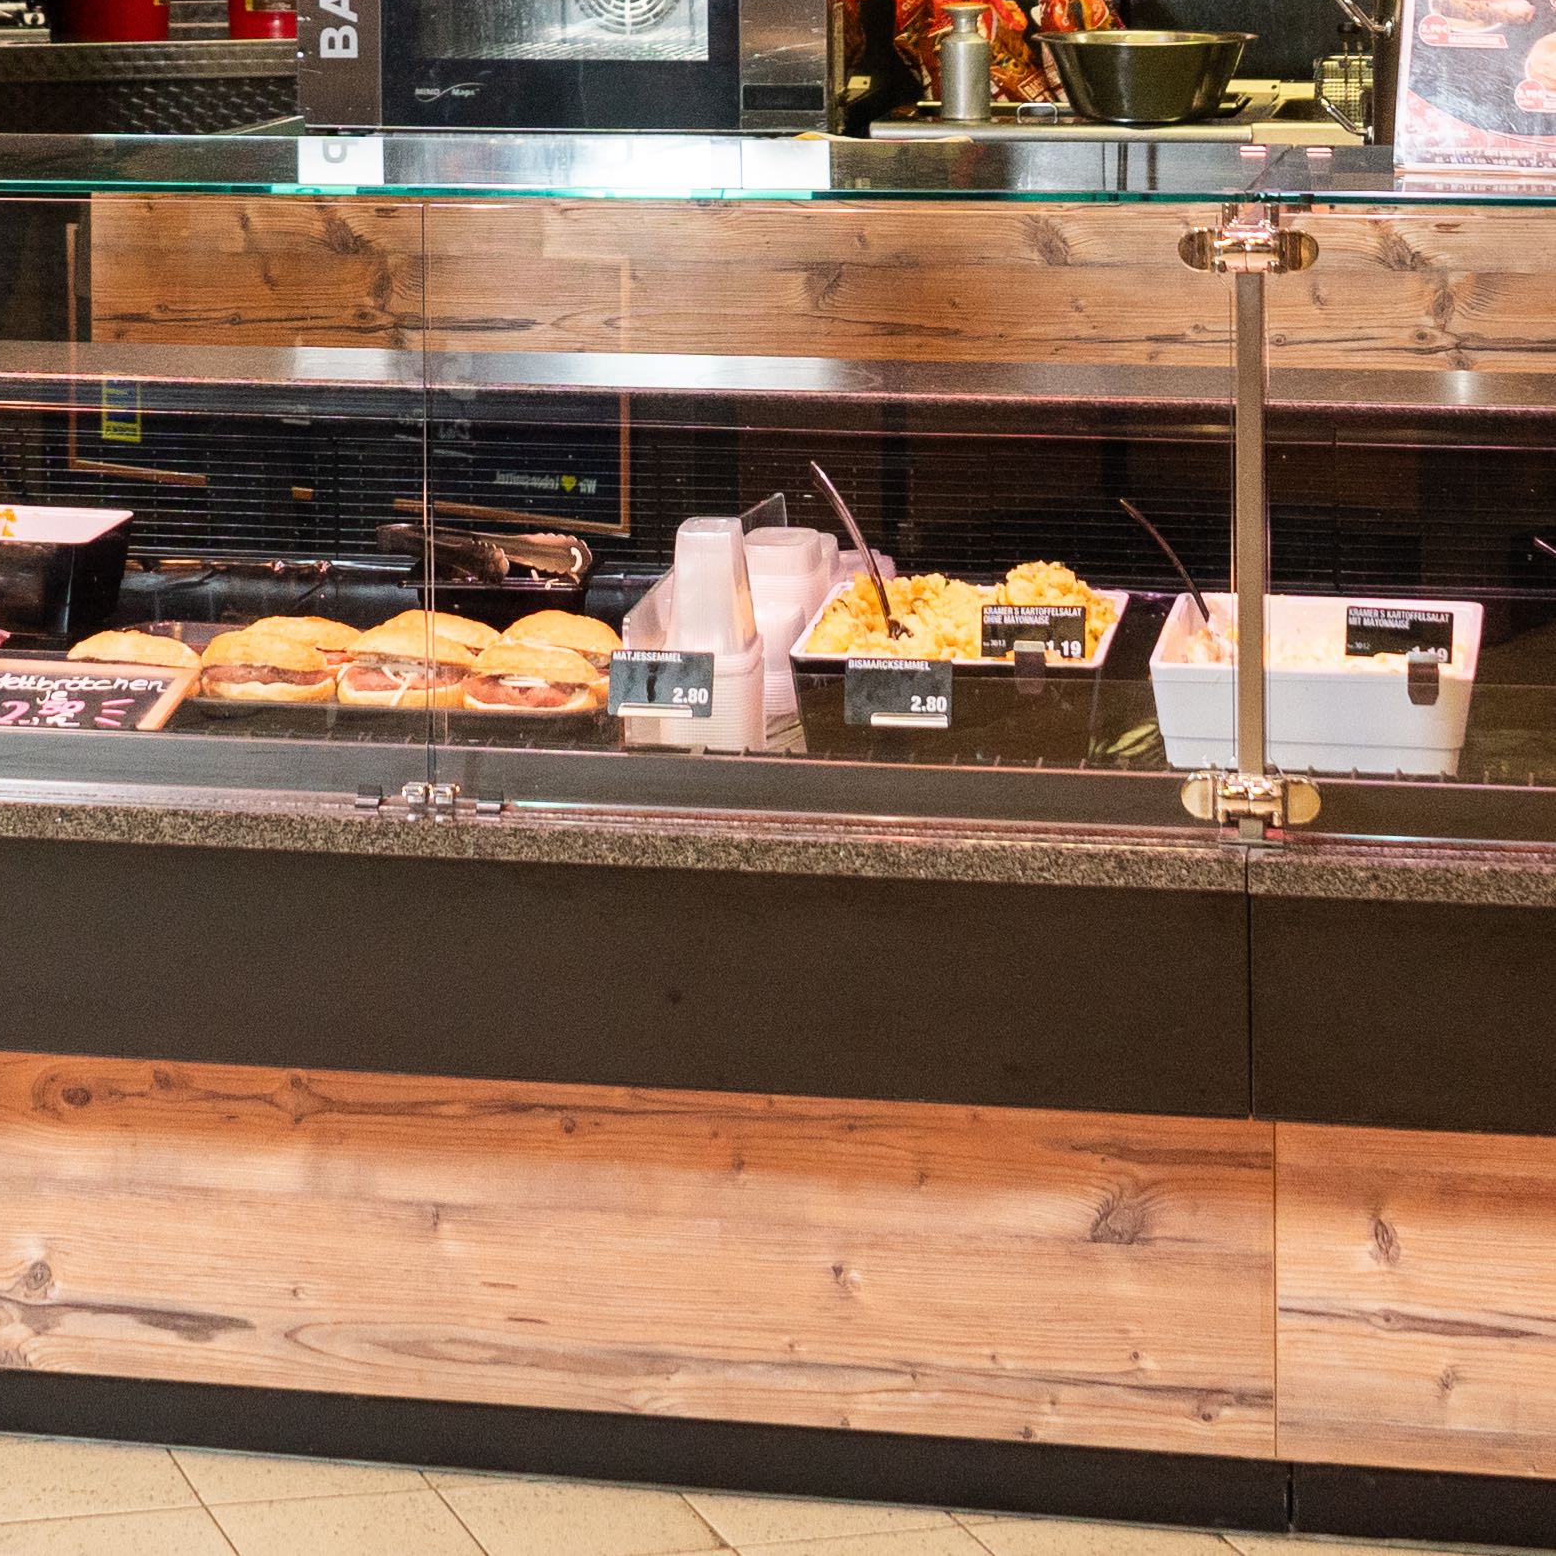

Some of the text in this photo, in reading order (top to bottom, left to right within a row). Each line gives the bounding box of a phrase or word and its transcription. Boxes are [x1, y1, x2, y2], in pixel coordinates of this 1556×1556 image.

[612, 650, 682, 662] MATJESSEMMEL
[848, 659, 931, 671] BISMARCKSEMMEL
[37, 690, 68, 706] je
[672, 687, 708, 704] 2.80
[911, 695, 947, 713] 2.80
